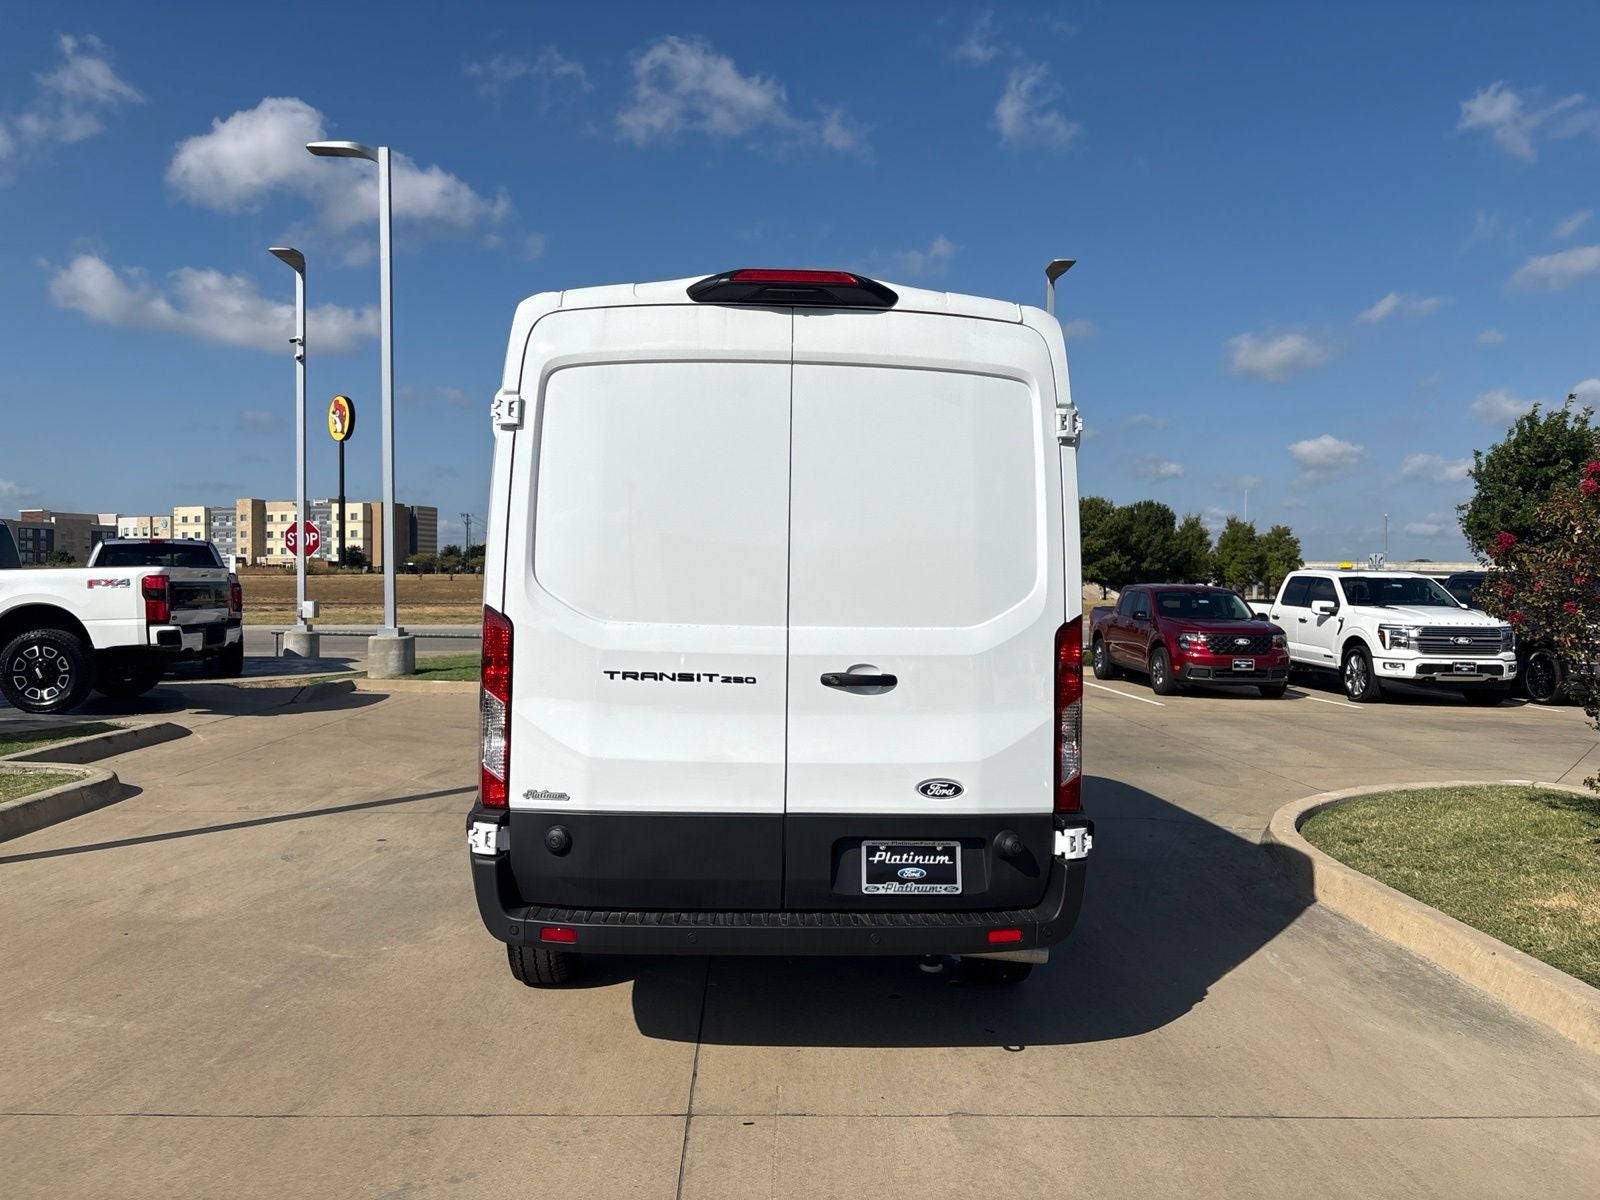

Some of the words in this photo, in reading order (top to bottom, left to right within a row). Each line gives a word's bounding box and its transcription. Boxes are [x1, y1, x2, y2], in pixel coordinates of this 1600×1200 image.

[287, 532, 318, 546] SP
[87, 579, 131, 589] FX4
[603, 670, 719, 683] TRANSIT
[720, 676, 757, 684] 250
[522, 789, 570, 801] Platinum
[927, 783, 956, 796] Ford
[868, 851, 953, 864] Platinum
[903, 868, 921, 878] Ford
[883, 881, 943, 893] Platinum
